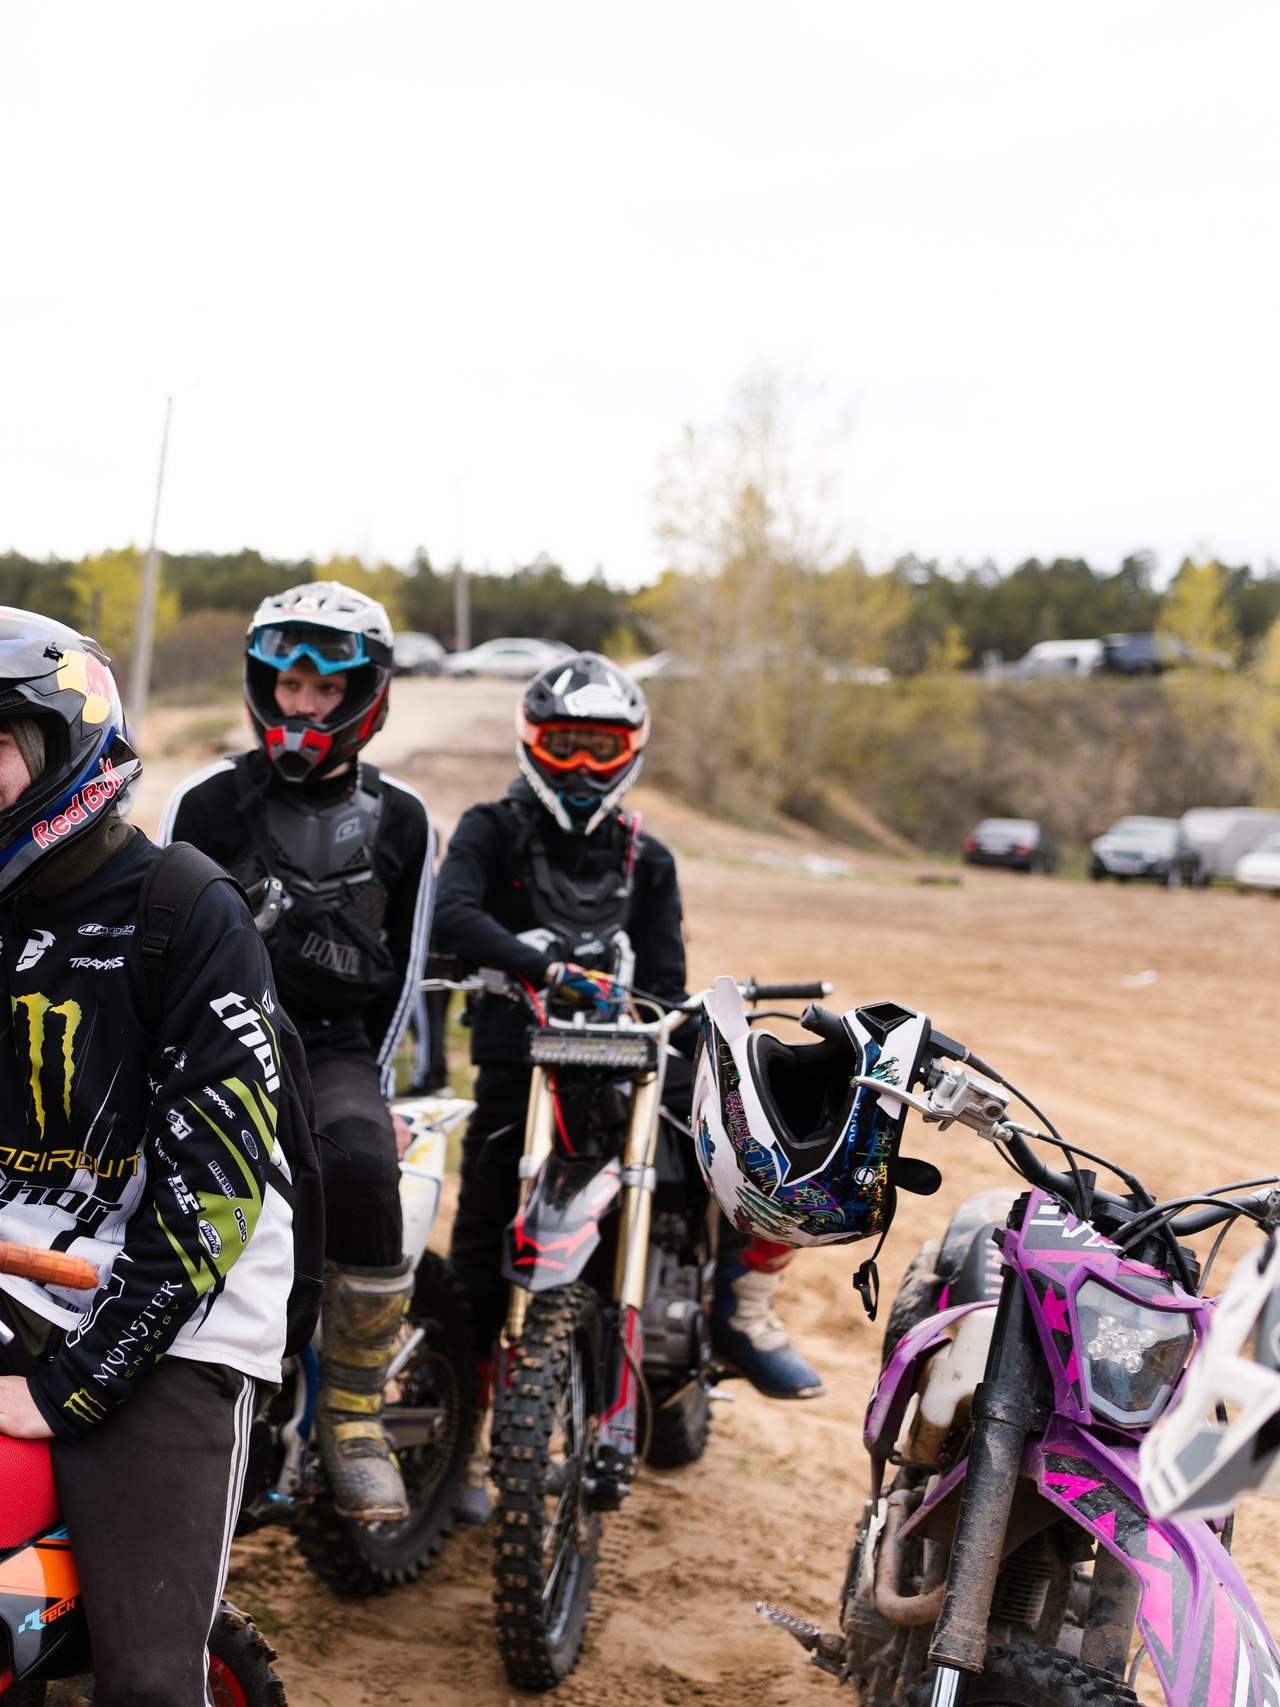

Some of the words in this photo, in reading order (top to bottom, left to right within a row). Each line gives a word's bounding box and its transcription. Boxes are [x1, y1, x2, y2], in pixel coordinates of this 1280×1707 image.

[31, 793, 89, 849] Red
[81, 758, 125, 813] Bull
[203, 1086, 236, 1119] TRAXXAS
[167, 1112, 190, 1136] GT
[172, 1175, 200, 1211] DP
[209, 1160, 237, 1198] HINSON
[233, 1206, 248, 1245] OGIO
[124, 1303, 180, 1379] ENERGY
